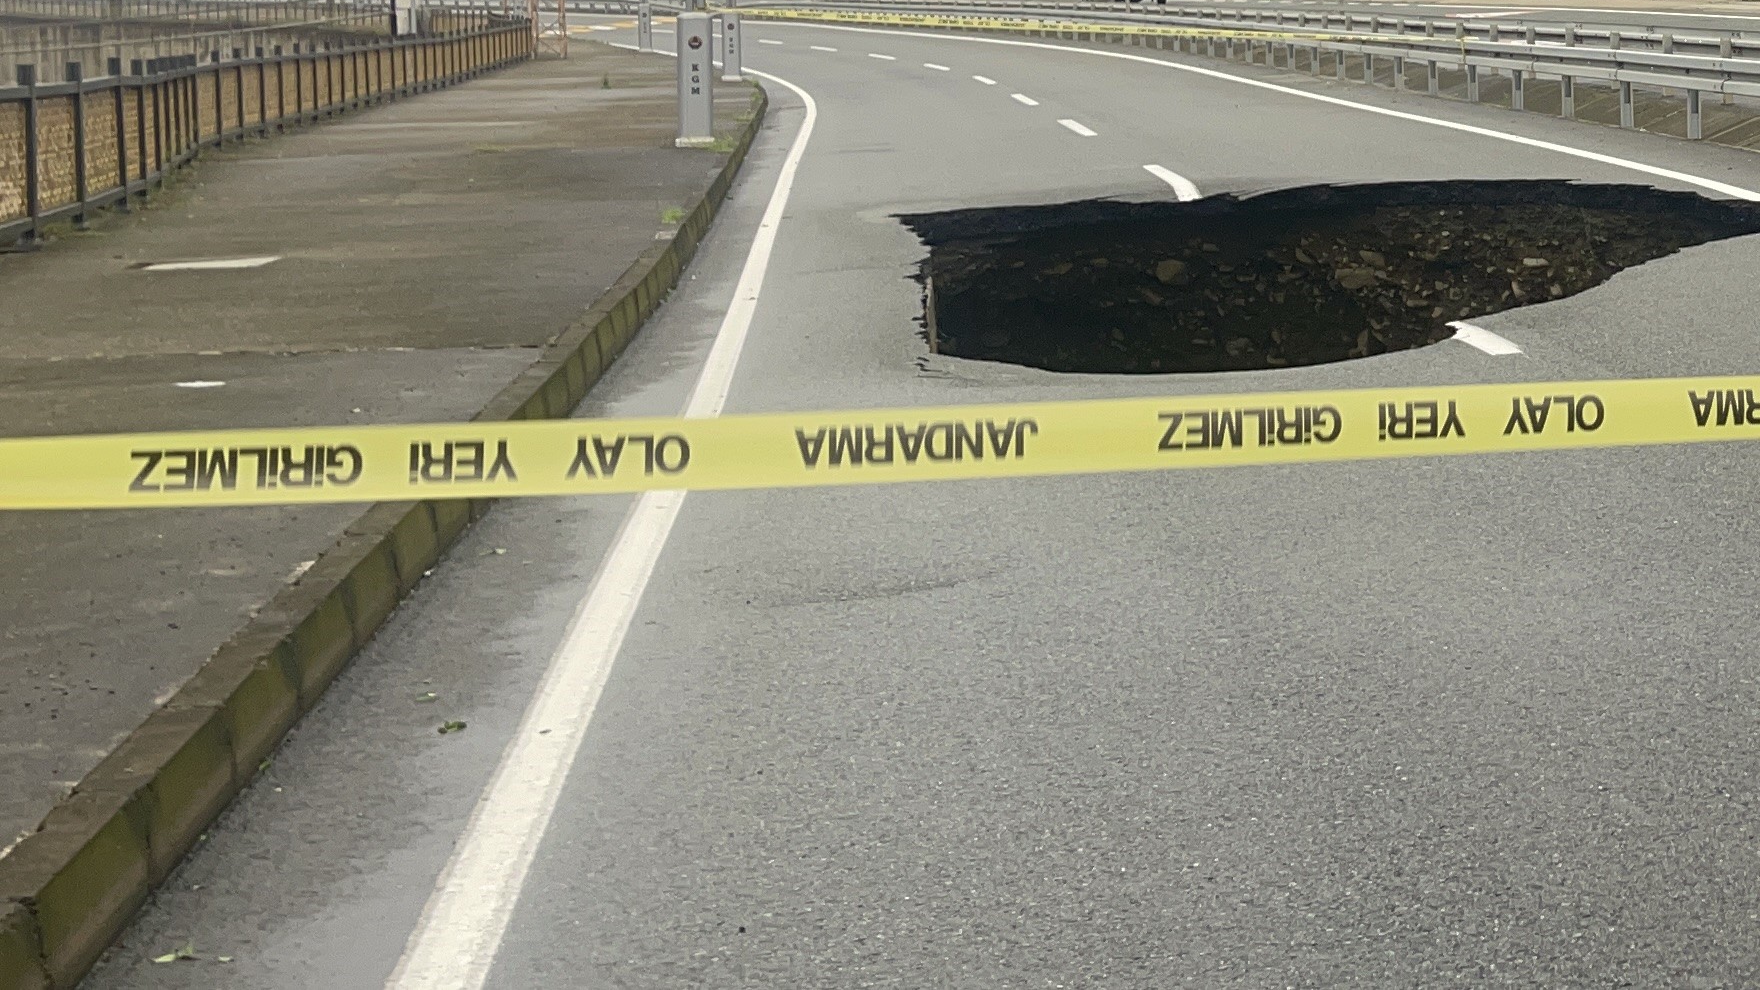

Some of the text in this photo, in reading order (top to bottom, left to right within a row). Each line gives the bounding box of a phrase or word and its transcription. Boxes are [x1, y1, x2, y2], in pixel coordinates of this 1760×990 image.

[691, 63, 700, 95] KGM
[1503, 396, 1606, 437] OLAY
[567, 435, 692, 479] OLAY
[795, 420, 1040, 469] JANDARMA
